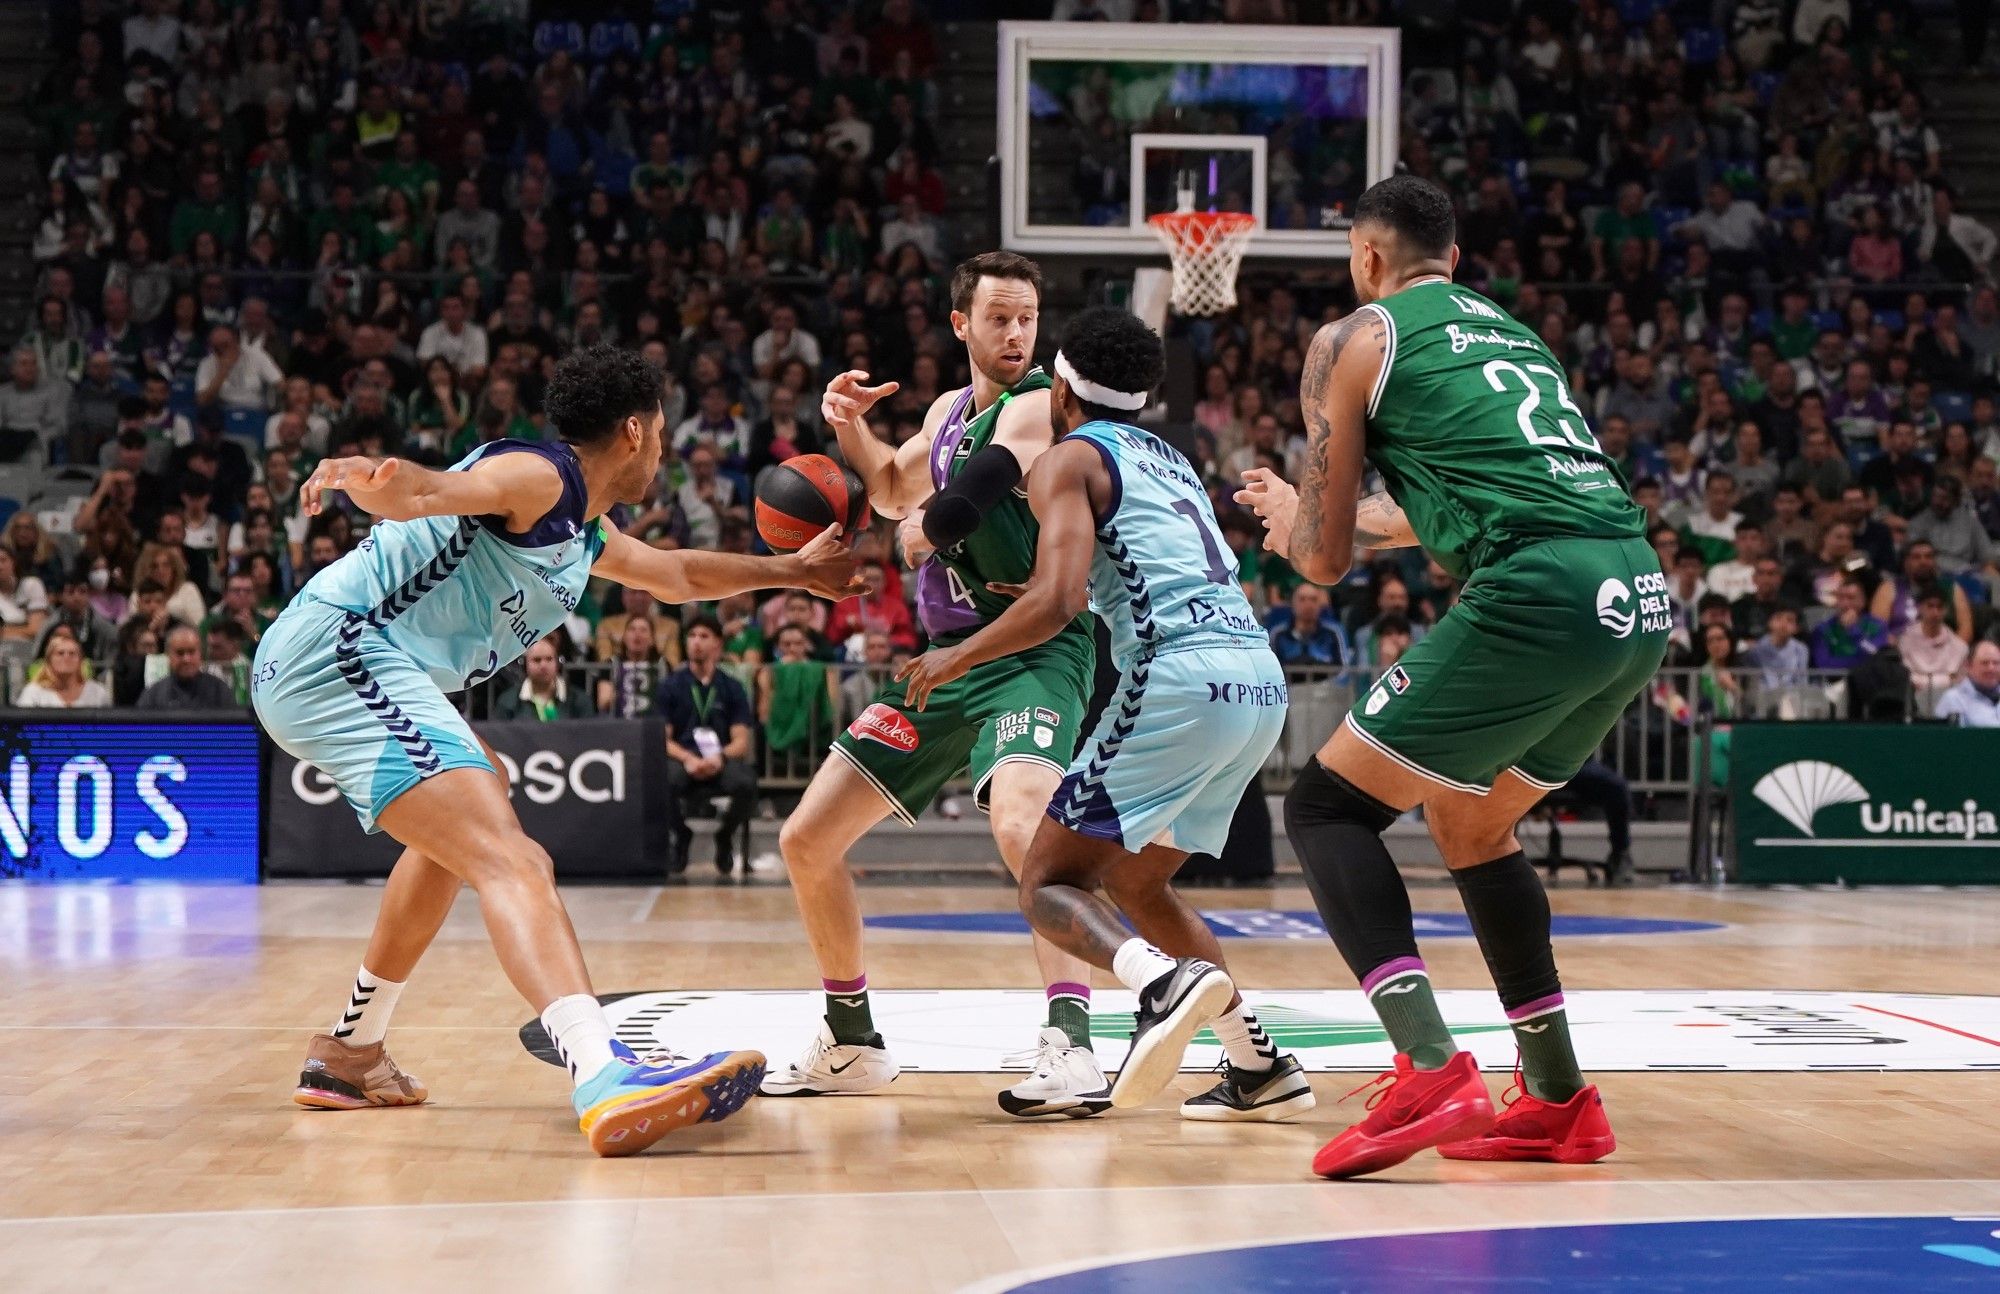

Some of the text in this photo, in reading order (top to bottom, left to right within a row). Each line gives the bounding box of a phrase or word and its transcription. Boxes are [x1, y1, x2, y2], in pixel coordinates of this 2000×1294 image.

[1483, 360, 1602, 454] 23
[945, 566, 977, 610] 4
[1640, 596, 1664, 615] DEL
[1861, 798, 1998, 840] Unicaja
